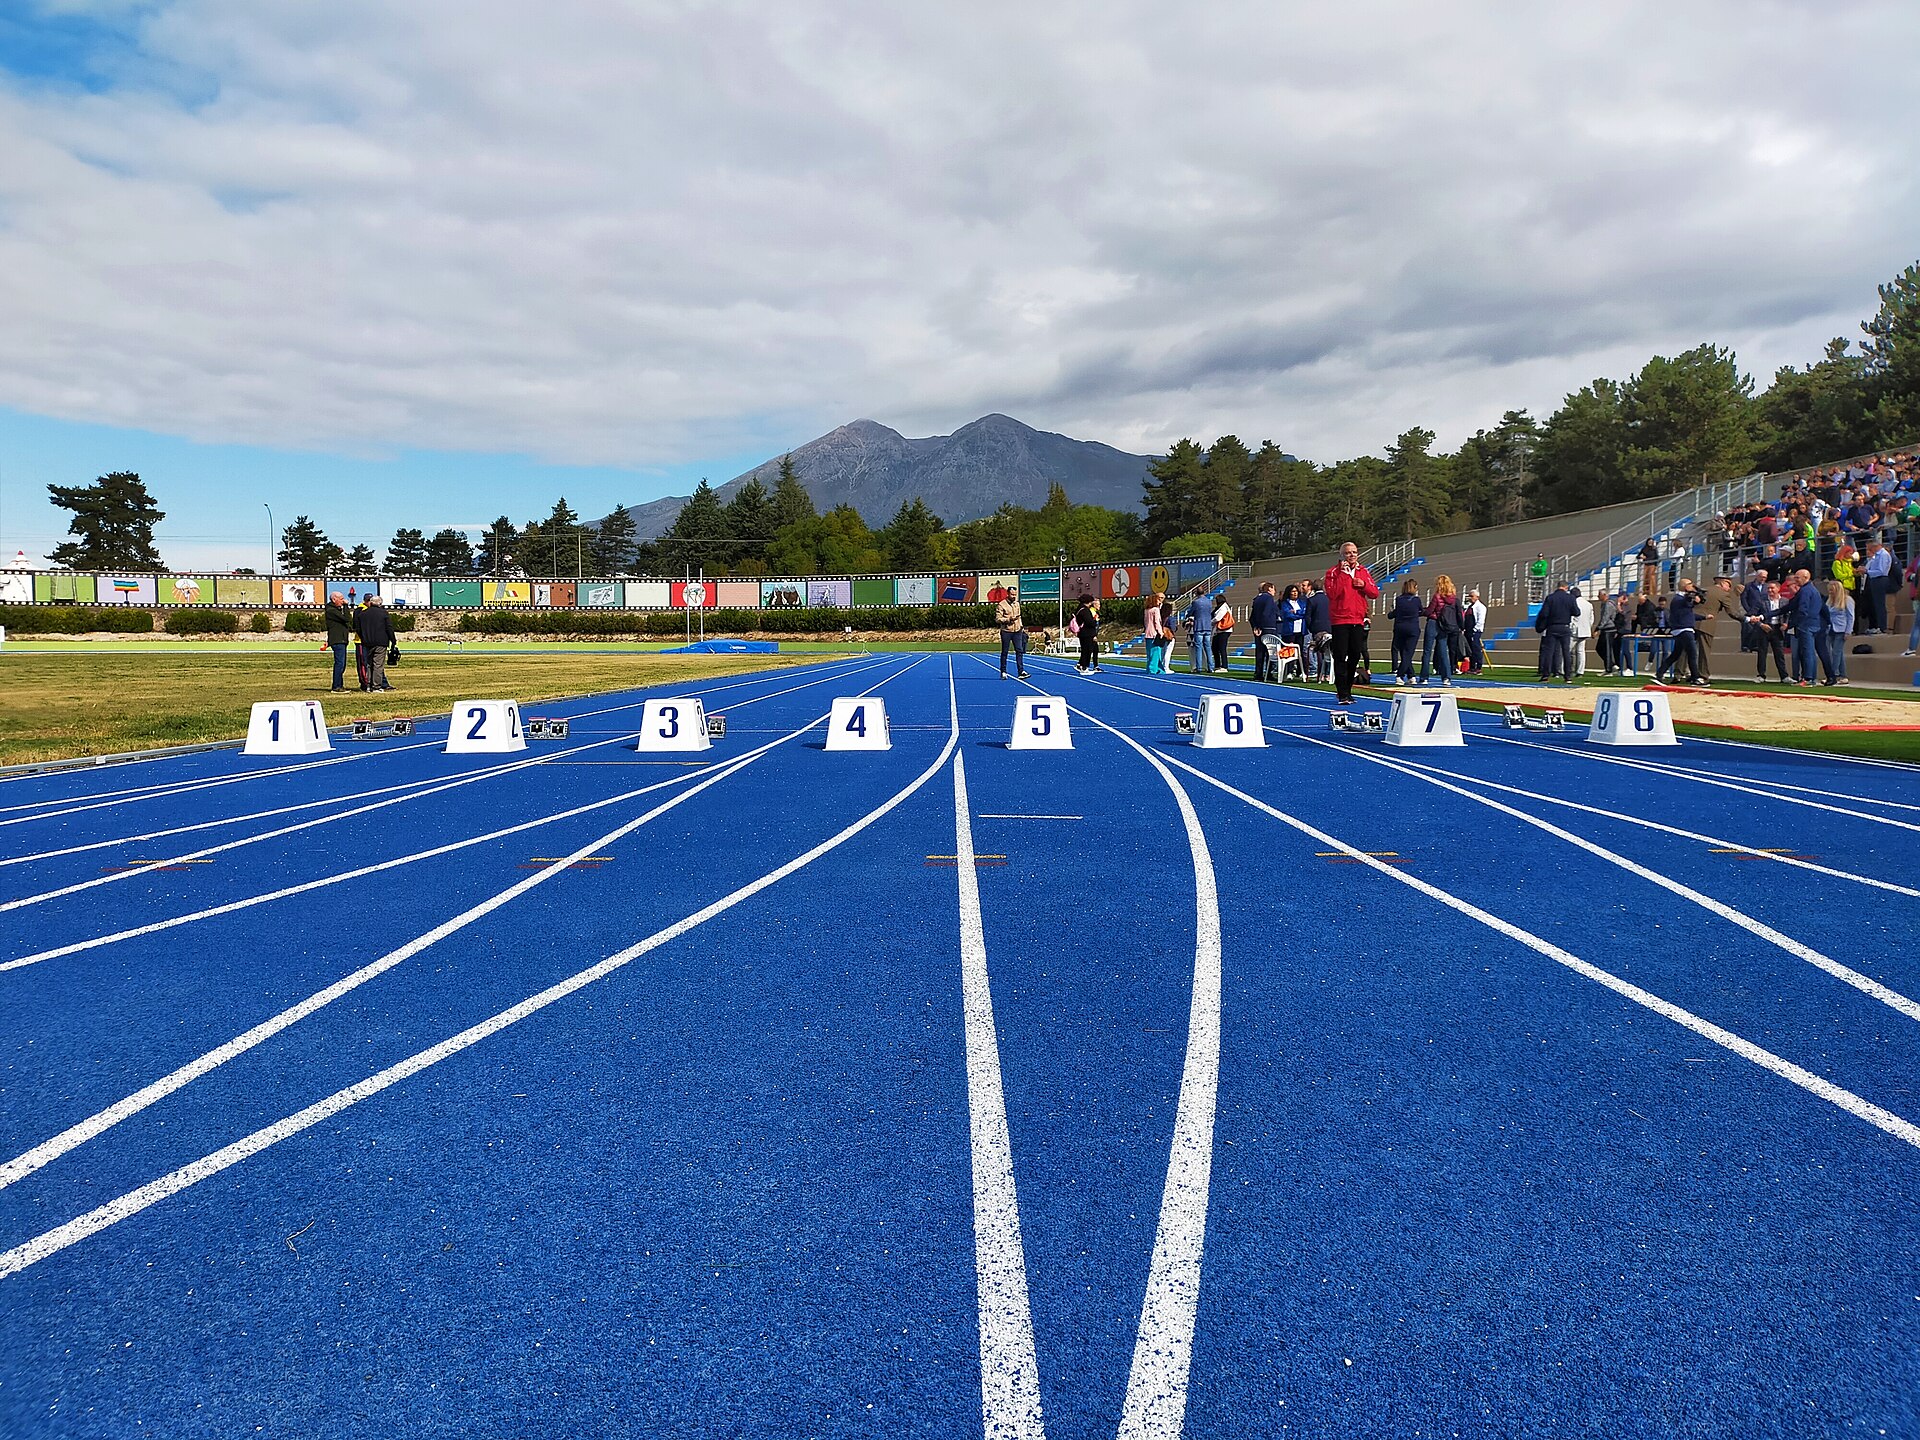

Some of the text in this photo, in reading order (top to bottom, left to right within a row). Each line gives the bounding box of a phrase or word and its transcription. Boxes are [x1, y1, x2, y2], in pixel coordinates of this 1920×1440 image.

[268, 710, 279, 741] 1
[310, 708, 318, 739] 1
[467, 708, 487, 740] 2
[508, 706, 518, 738] 2
[659, 706, 679, 738] 3
[696, 705, 705, 736] 3
[846, 706, 866, 737] 4
[1032, 704, 1050, 736] 5
[1224, 703, 1243, 734] 6
[1389, 700, 1400, 730] 7
[1421, 701, 1441, 733] 7
[1600, 699, 1610, 730] 8
[1634, 700, 1654, 732] 8
